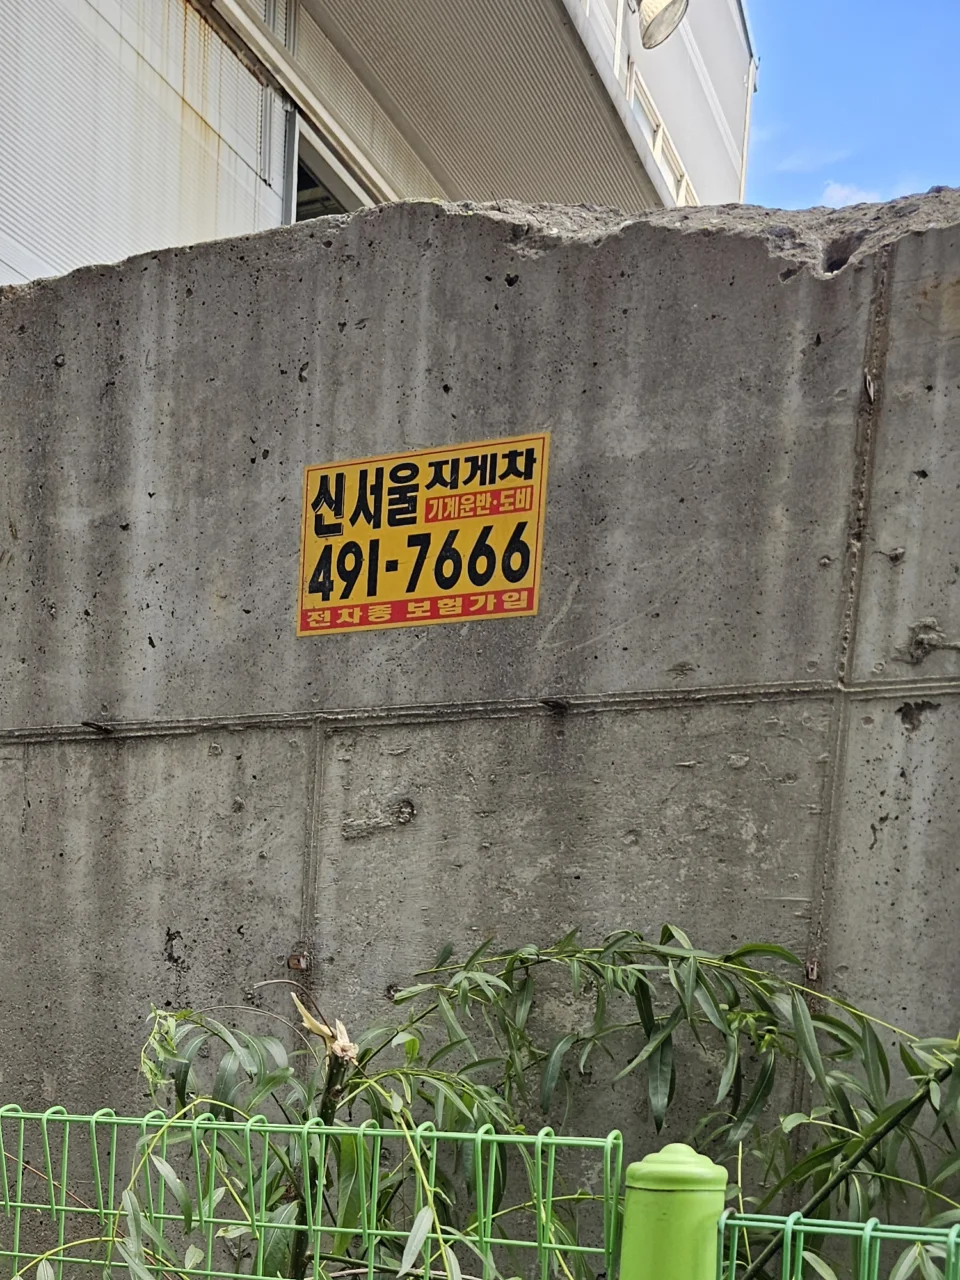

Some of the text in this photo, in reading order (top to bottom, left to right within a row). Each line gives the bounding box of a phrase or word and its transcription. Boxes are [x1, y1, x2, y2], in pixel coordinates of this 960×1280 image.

[311, 448, 537, 538] 신서울 지게차
[308, 521, 531, 602] 491-7666
[307, 591, 528, 627] 전차종 보험가입
